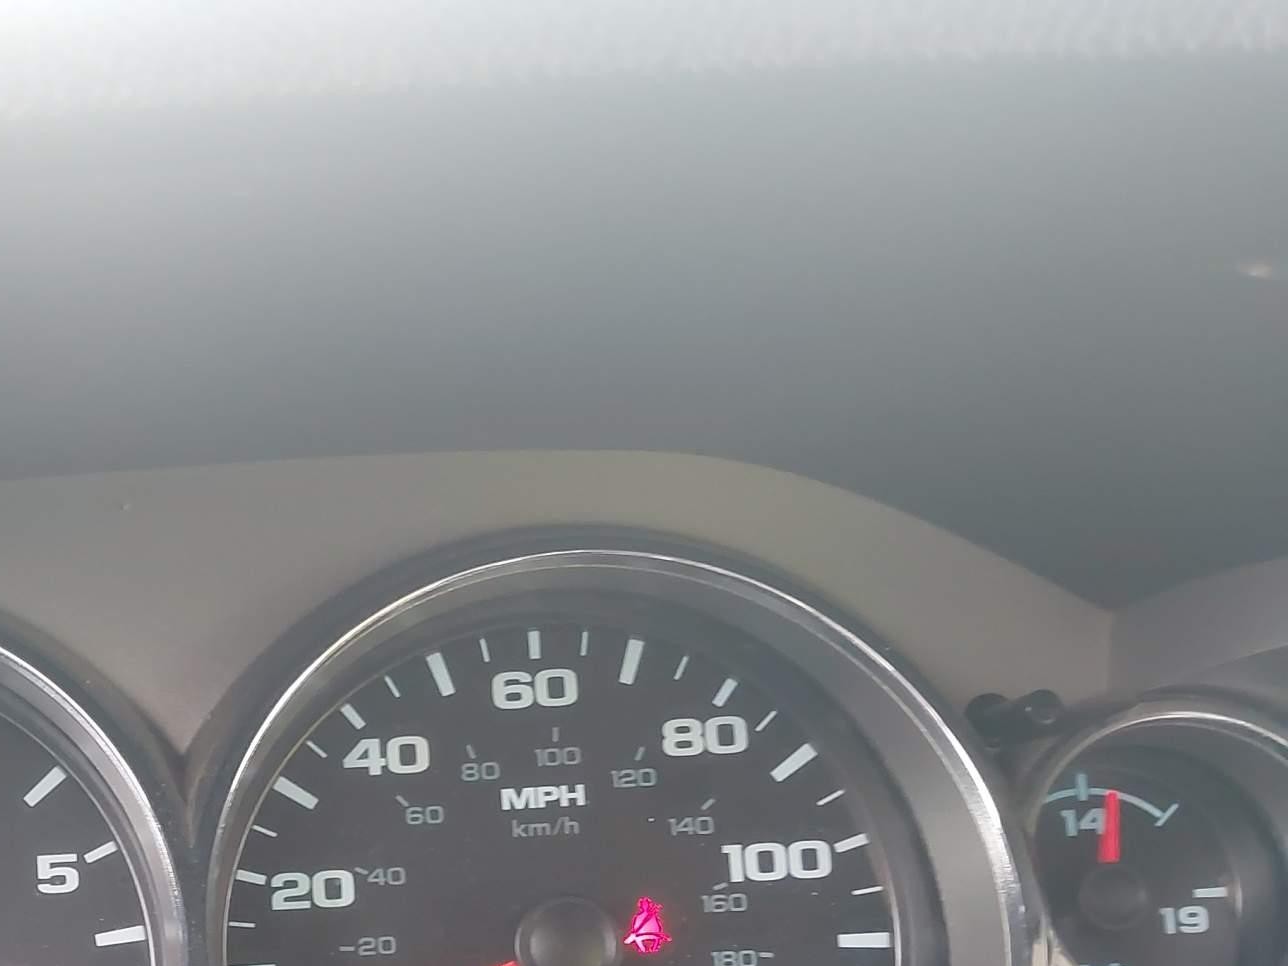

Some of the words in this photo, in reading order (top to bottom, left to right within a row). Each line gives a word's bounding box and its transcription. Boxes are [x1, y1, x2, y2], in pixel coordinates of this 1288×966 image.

[490, 668, 579, 711] 60
[661, 716, 749, 757] 80
[342, 735, 431, 776] 40
[534, 746, 582, 767] 100
[461, 761, 501, 782] 80
[611, 768, 657, 788] 120
[500, 784, 587, 811] MPH
[405, 805, 445, 825] 60
[667, 816, 715, 836] 140
[1060, 808, 1108, 837] 14
[512, 817, 580, 838] km/h
[36, 853, 80, 894] 5
[720, 840, 833, 883] 100
[367, 867, 406, 886] 40
[270, 869, 356, 911] 20
[700, 893, 748, 913] 160
[1158, 905, 1210, 935] 19
[357, 936, 397, 956] 20
